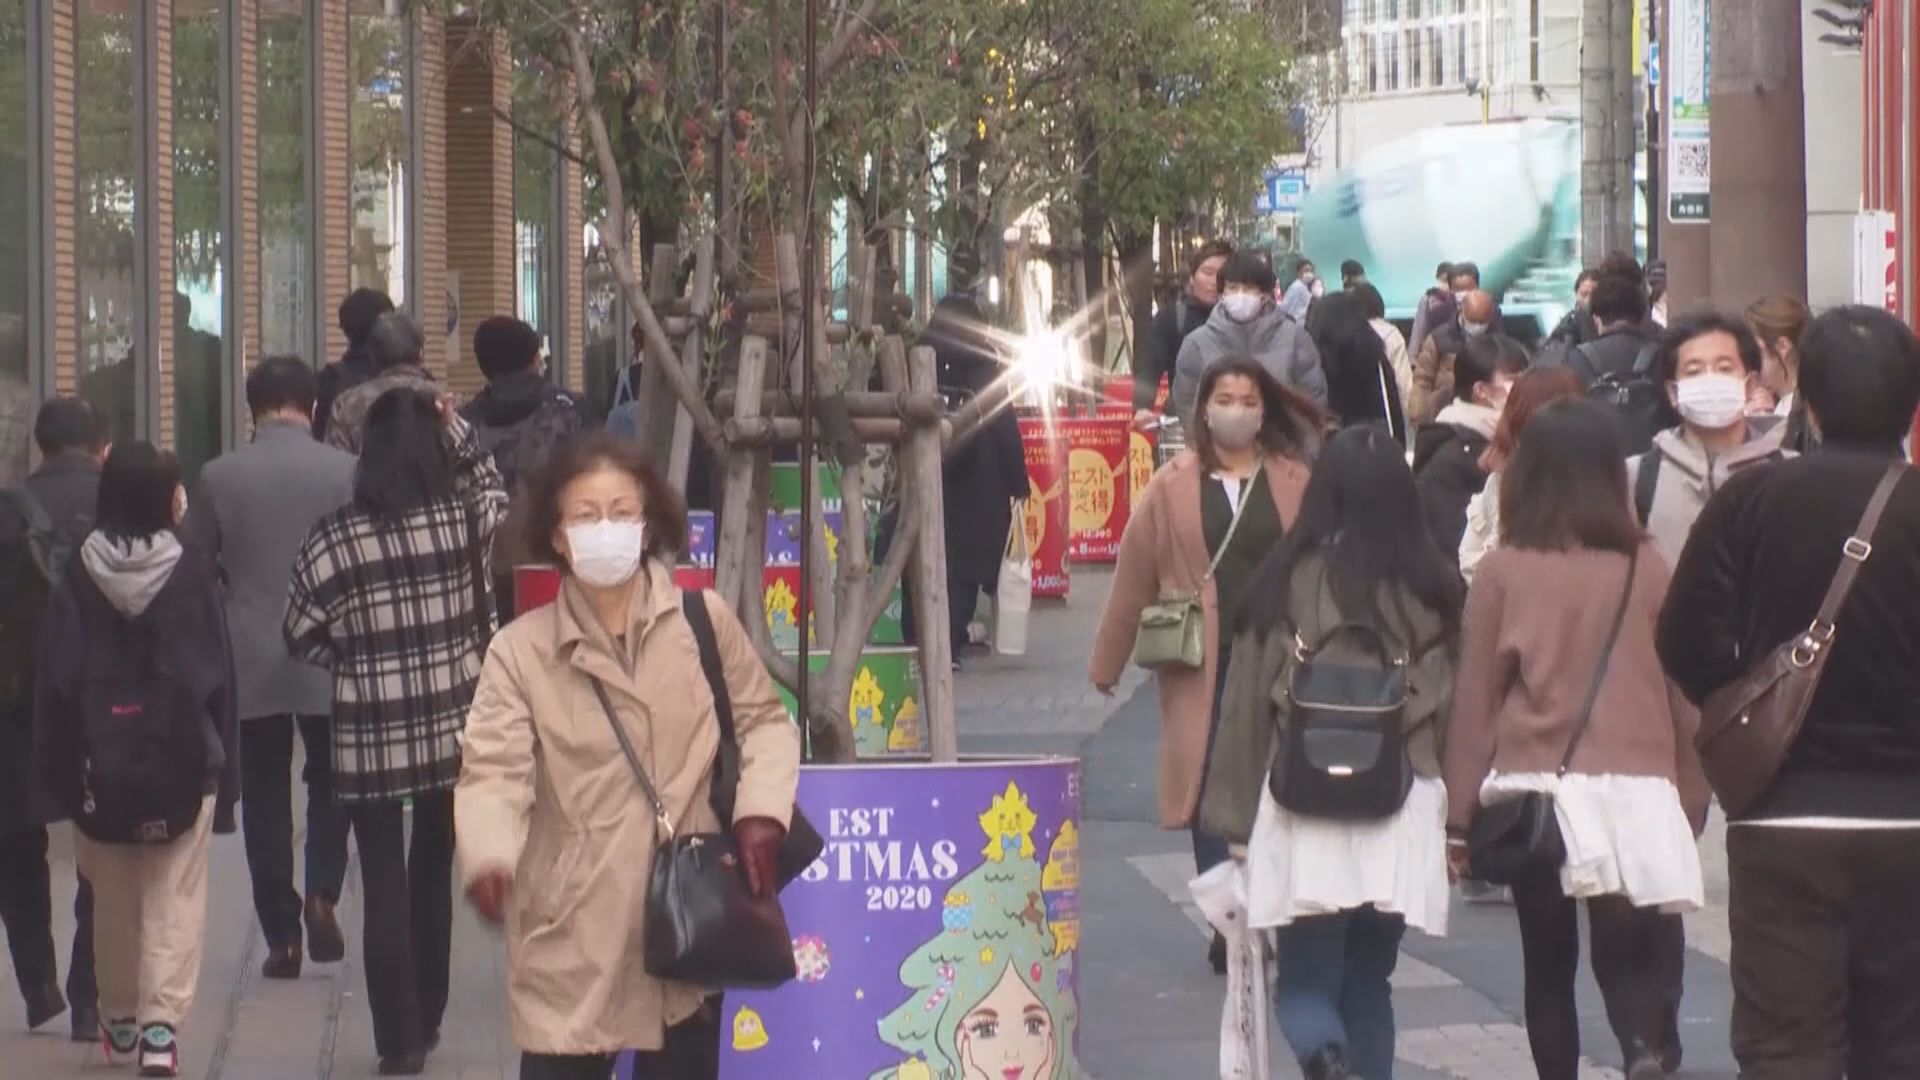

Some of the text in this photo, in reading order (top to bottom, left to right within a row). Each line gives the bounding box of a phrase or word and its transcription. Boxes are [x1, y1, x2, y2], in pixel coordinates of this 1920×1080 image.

[1070, 466, 1109, 486] エスト
[829, 807, 895, 837] EST
[794, 839, 959, 881] STMAS
[866, 885, 932, 911] 2020
